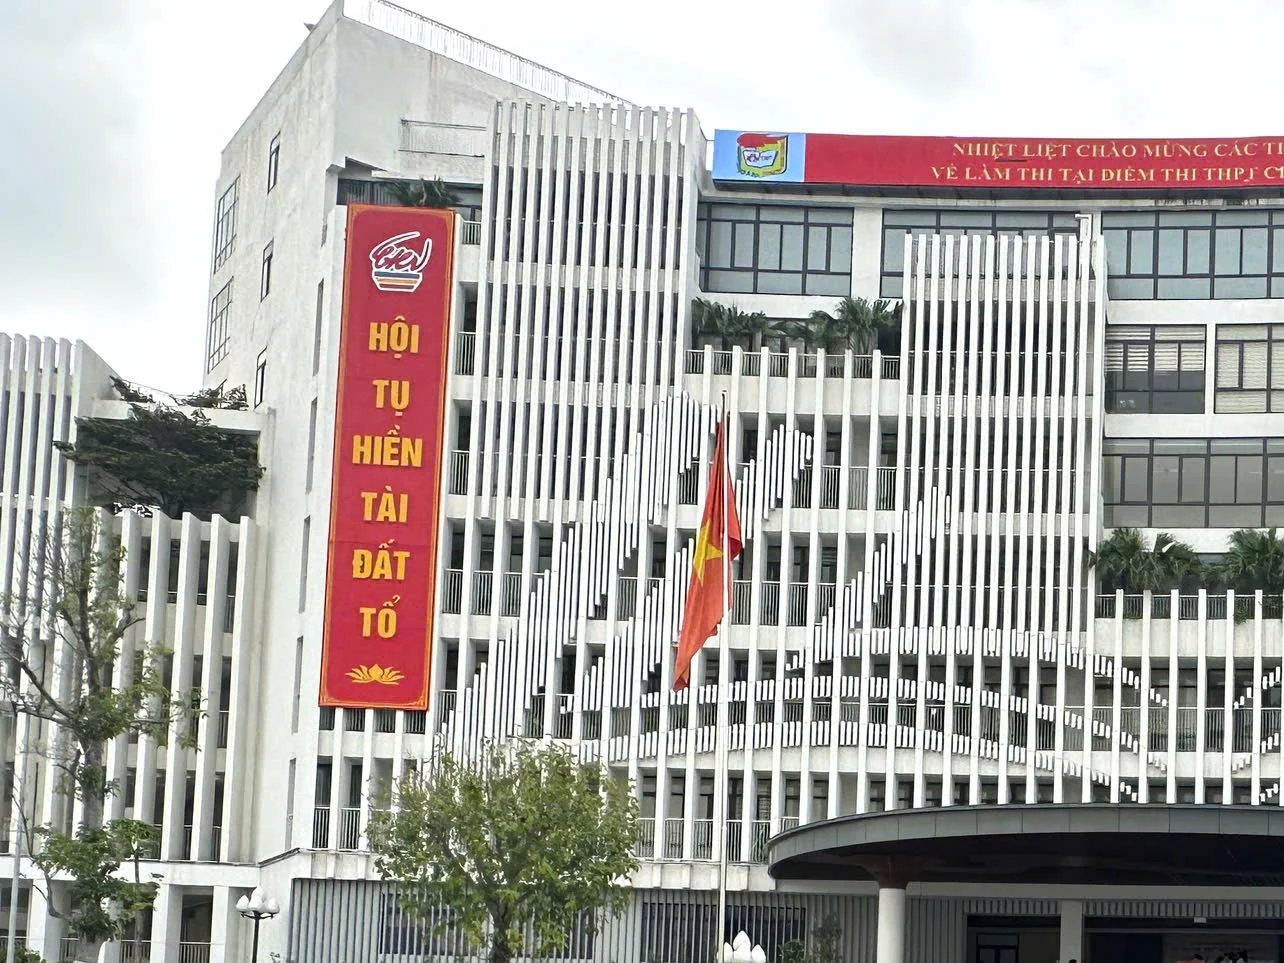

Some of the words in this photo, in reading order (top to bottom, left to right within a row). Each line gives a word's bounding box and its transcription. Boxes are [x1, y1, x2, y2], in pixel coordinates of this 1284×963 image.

[1076, 141, 1136, 158] CHÀO
[1215, 140, 1258, 156] CÁC
[965, 163, 1010, 181] LÀM
[1017, 167, 1052, 181] THI
[1059, 168, 1093, 184] TẠI
[1161, 168, 1197, 182] THI
[1202, 167, 1258, 182] THPT
[368, 315, 420, 359] HỘI
[372, 379, 410, 417] TỤ
[352, 424, 423, 467] HIỀN
[360, 485, 408, 523] TÀI
[352, 538, 410, 580] ĐẤT
[359, 594, 401, 639] TỔ
